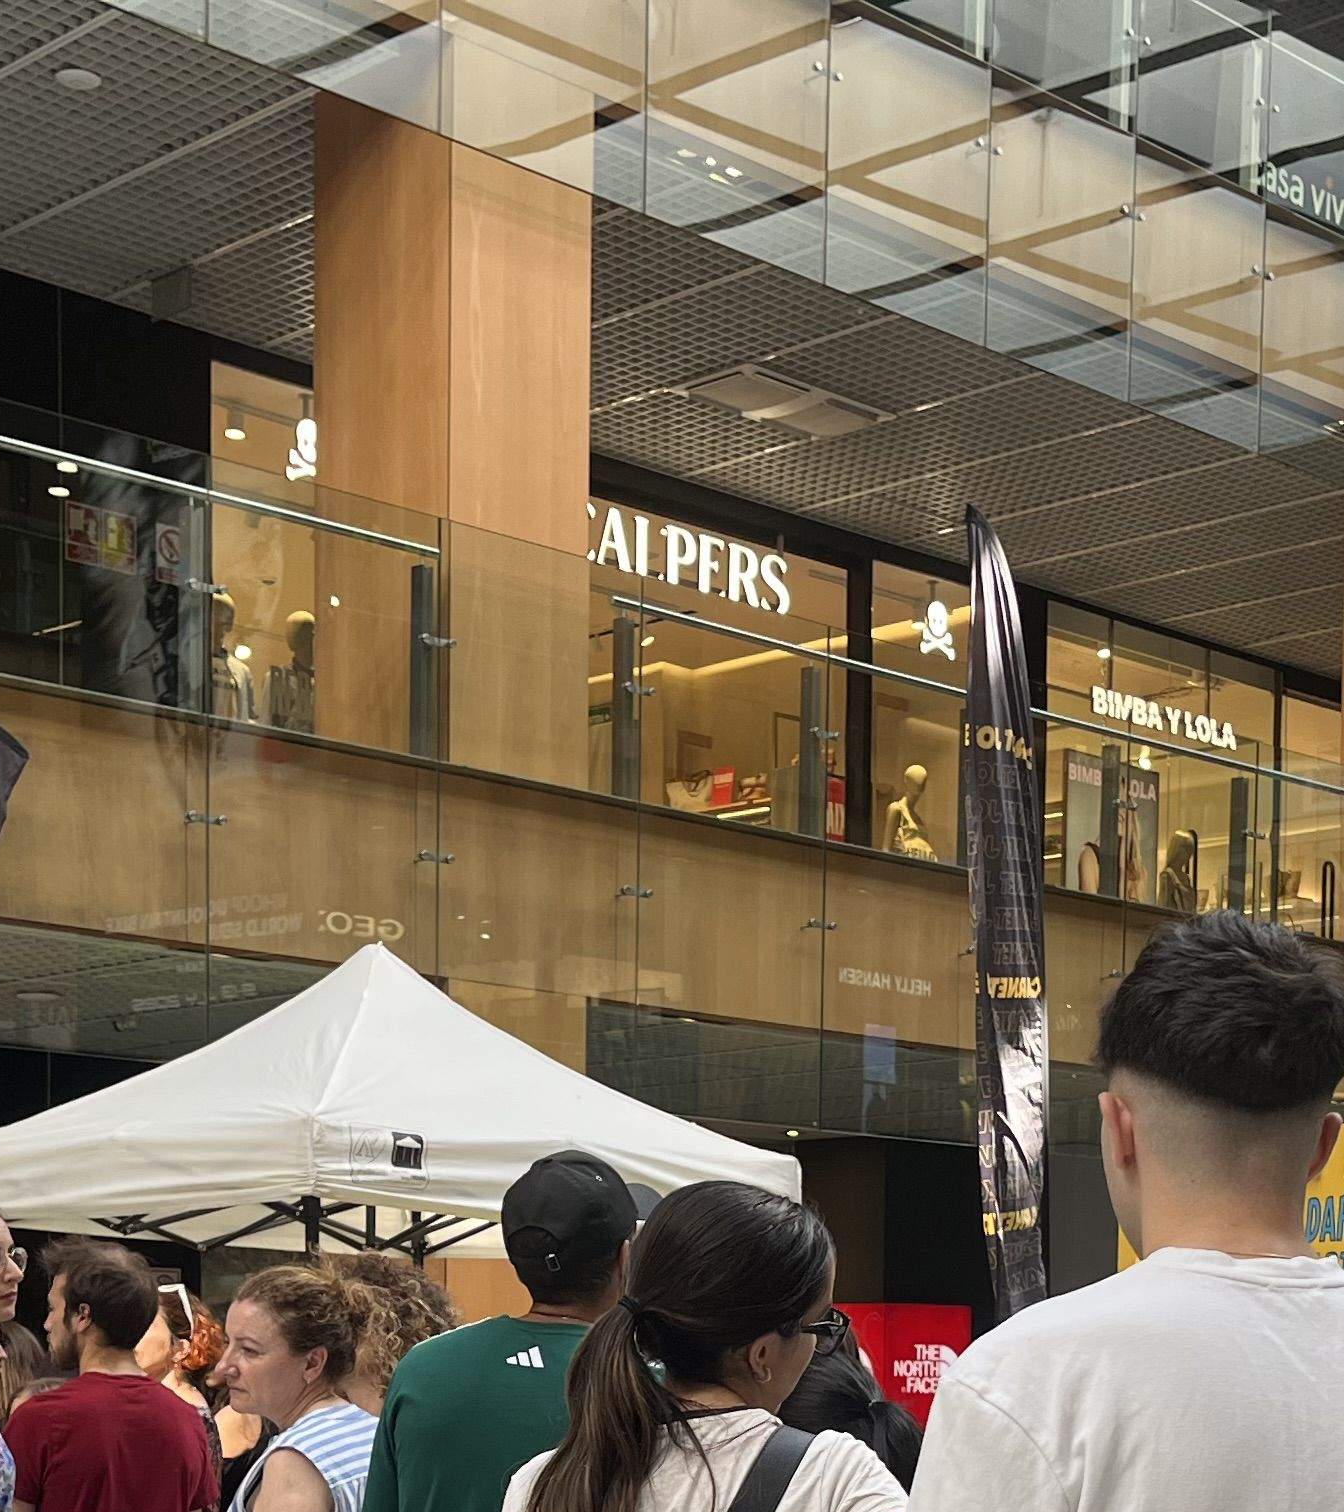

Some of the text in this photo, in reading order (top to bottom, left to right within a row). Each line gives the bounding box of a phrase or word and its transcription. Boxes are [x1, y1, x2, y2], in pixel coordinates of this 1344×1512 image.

[1092, 685, 1238, 751] BIMBA Y LOLA
[914, 1343, 941, 1362] THE
[893, 1359, 940, 1378] NORTH
[905, 1377, 939, 1394] FACE
